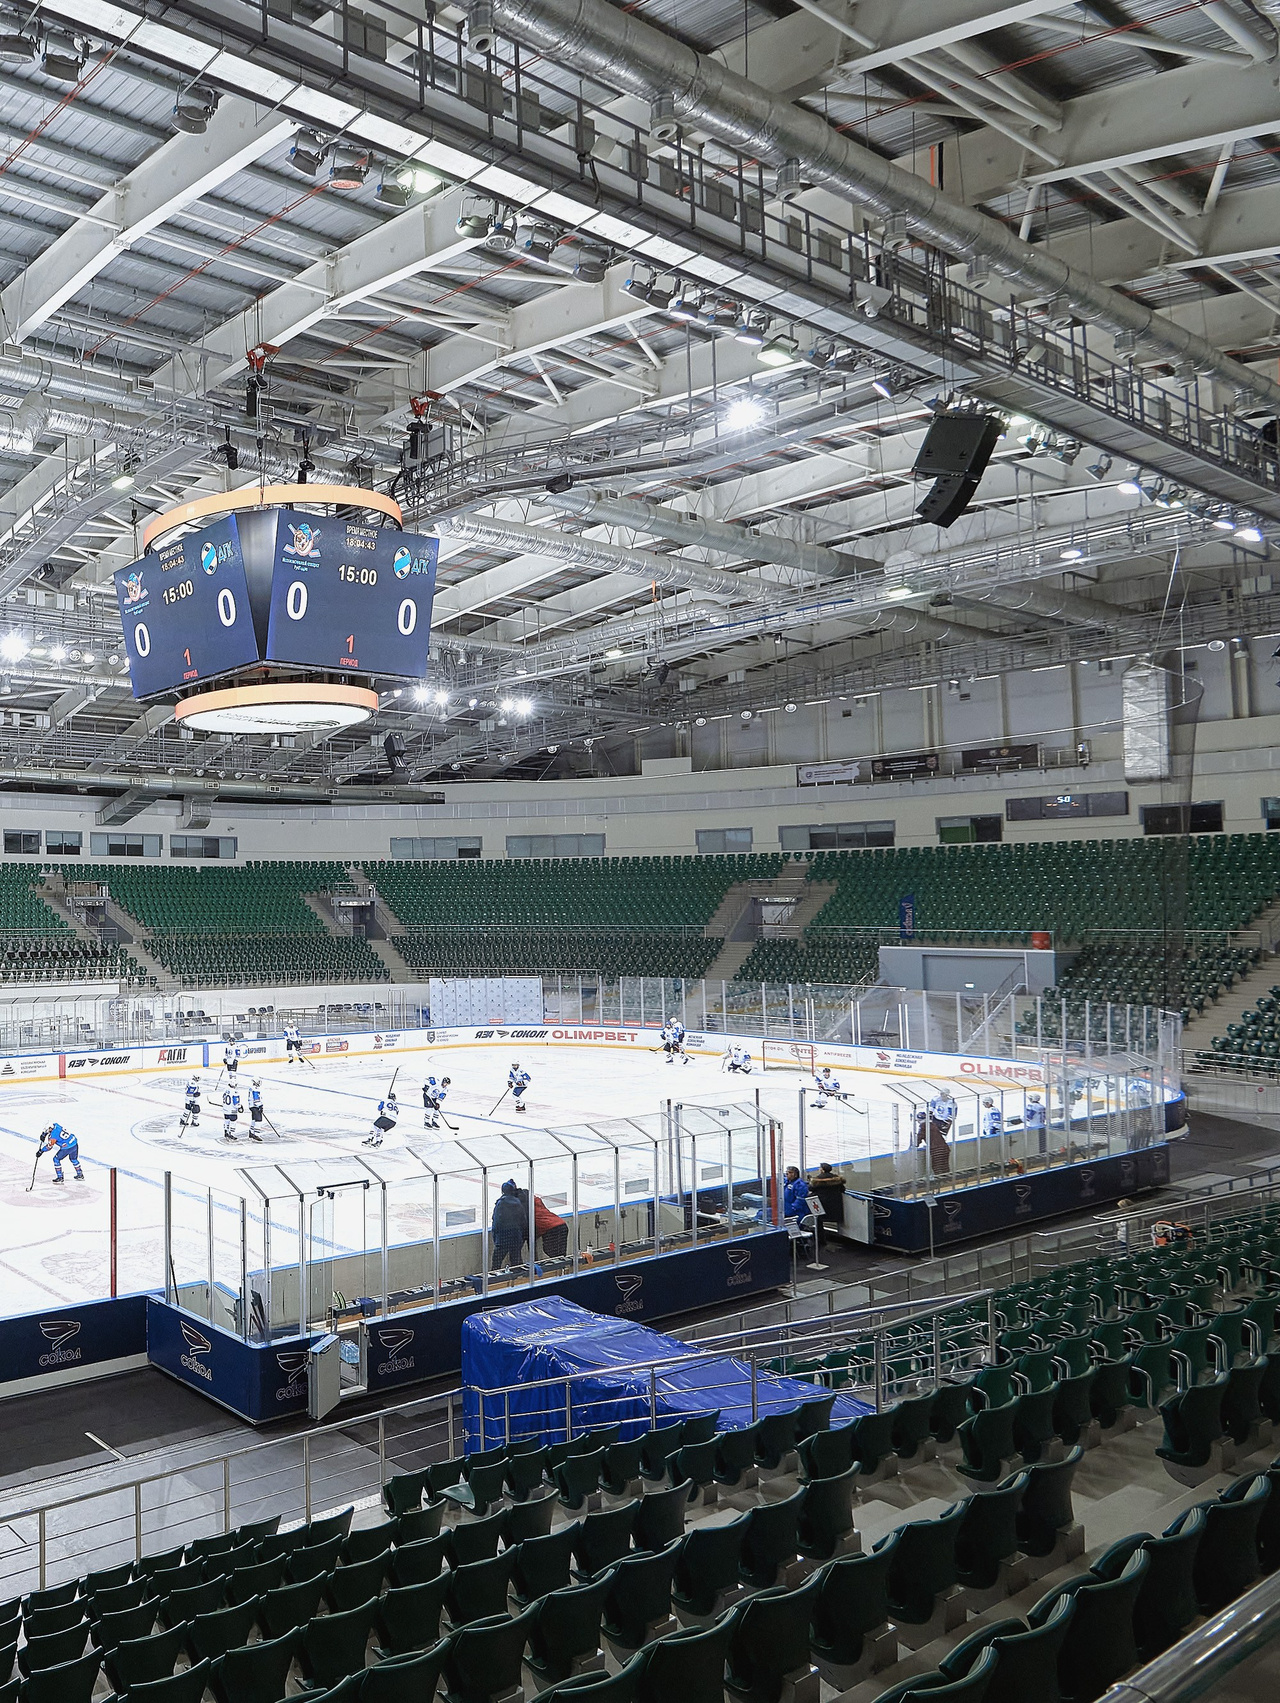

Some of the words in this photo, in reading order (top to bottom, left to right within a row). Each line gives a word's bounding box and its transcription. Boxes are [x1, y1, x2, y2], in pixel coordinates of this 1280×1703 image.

[346, 538, 376, 550] 18:04:43
[338, 564, 377, 586] 15:00
[162, 580, 193, 605] 15:00
[286, 581, 308, 620] 0
[218, 588, 236, 627] 0
[397, 598, 417, 636] 0
[134, 622, 151, 657] 0
[346, 634, 355, 653] 1
[183, 648, 191, 666] 1
[339, 657, 359, 667] ПЕРИОД
[510, 1030, 548, 1039] СОКОЛ!
[552, 1030, 638, 1042] OLIMPBET
[100, 1056, 130, 1066] СОКОЛ!
[960, 1062, 1043, 1081] OLIMPB
[276, 1381, 308, 1401] соко
